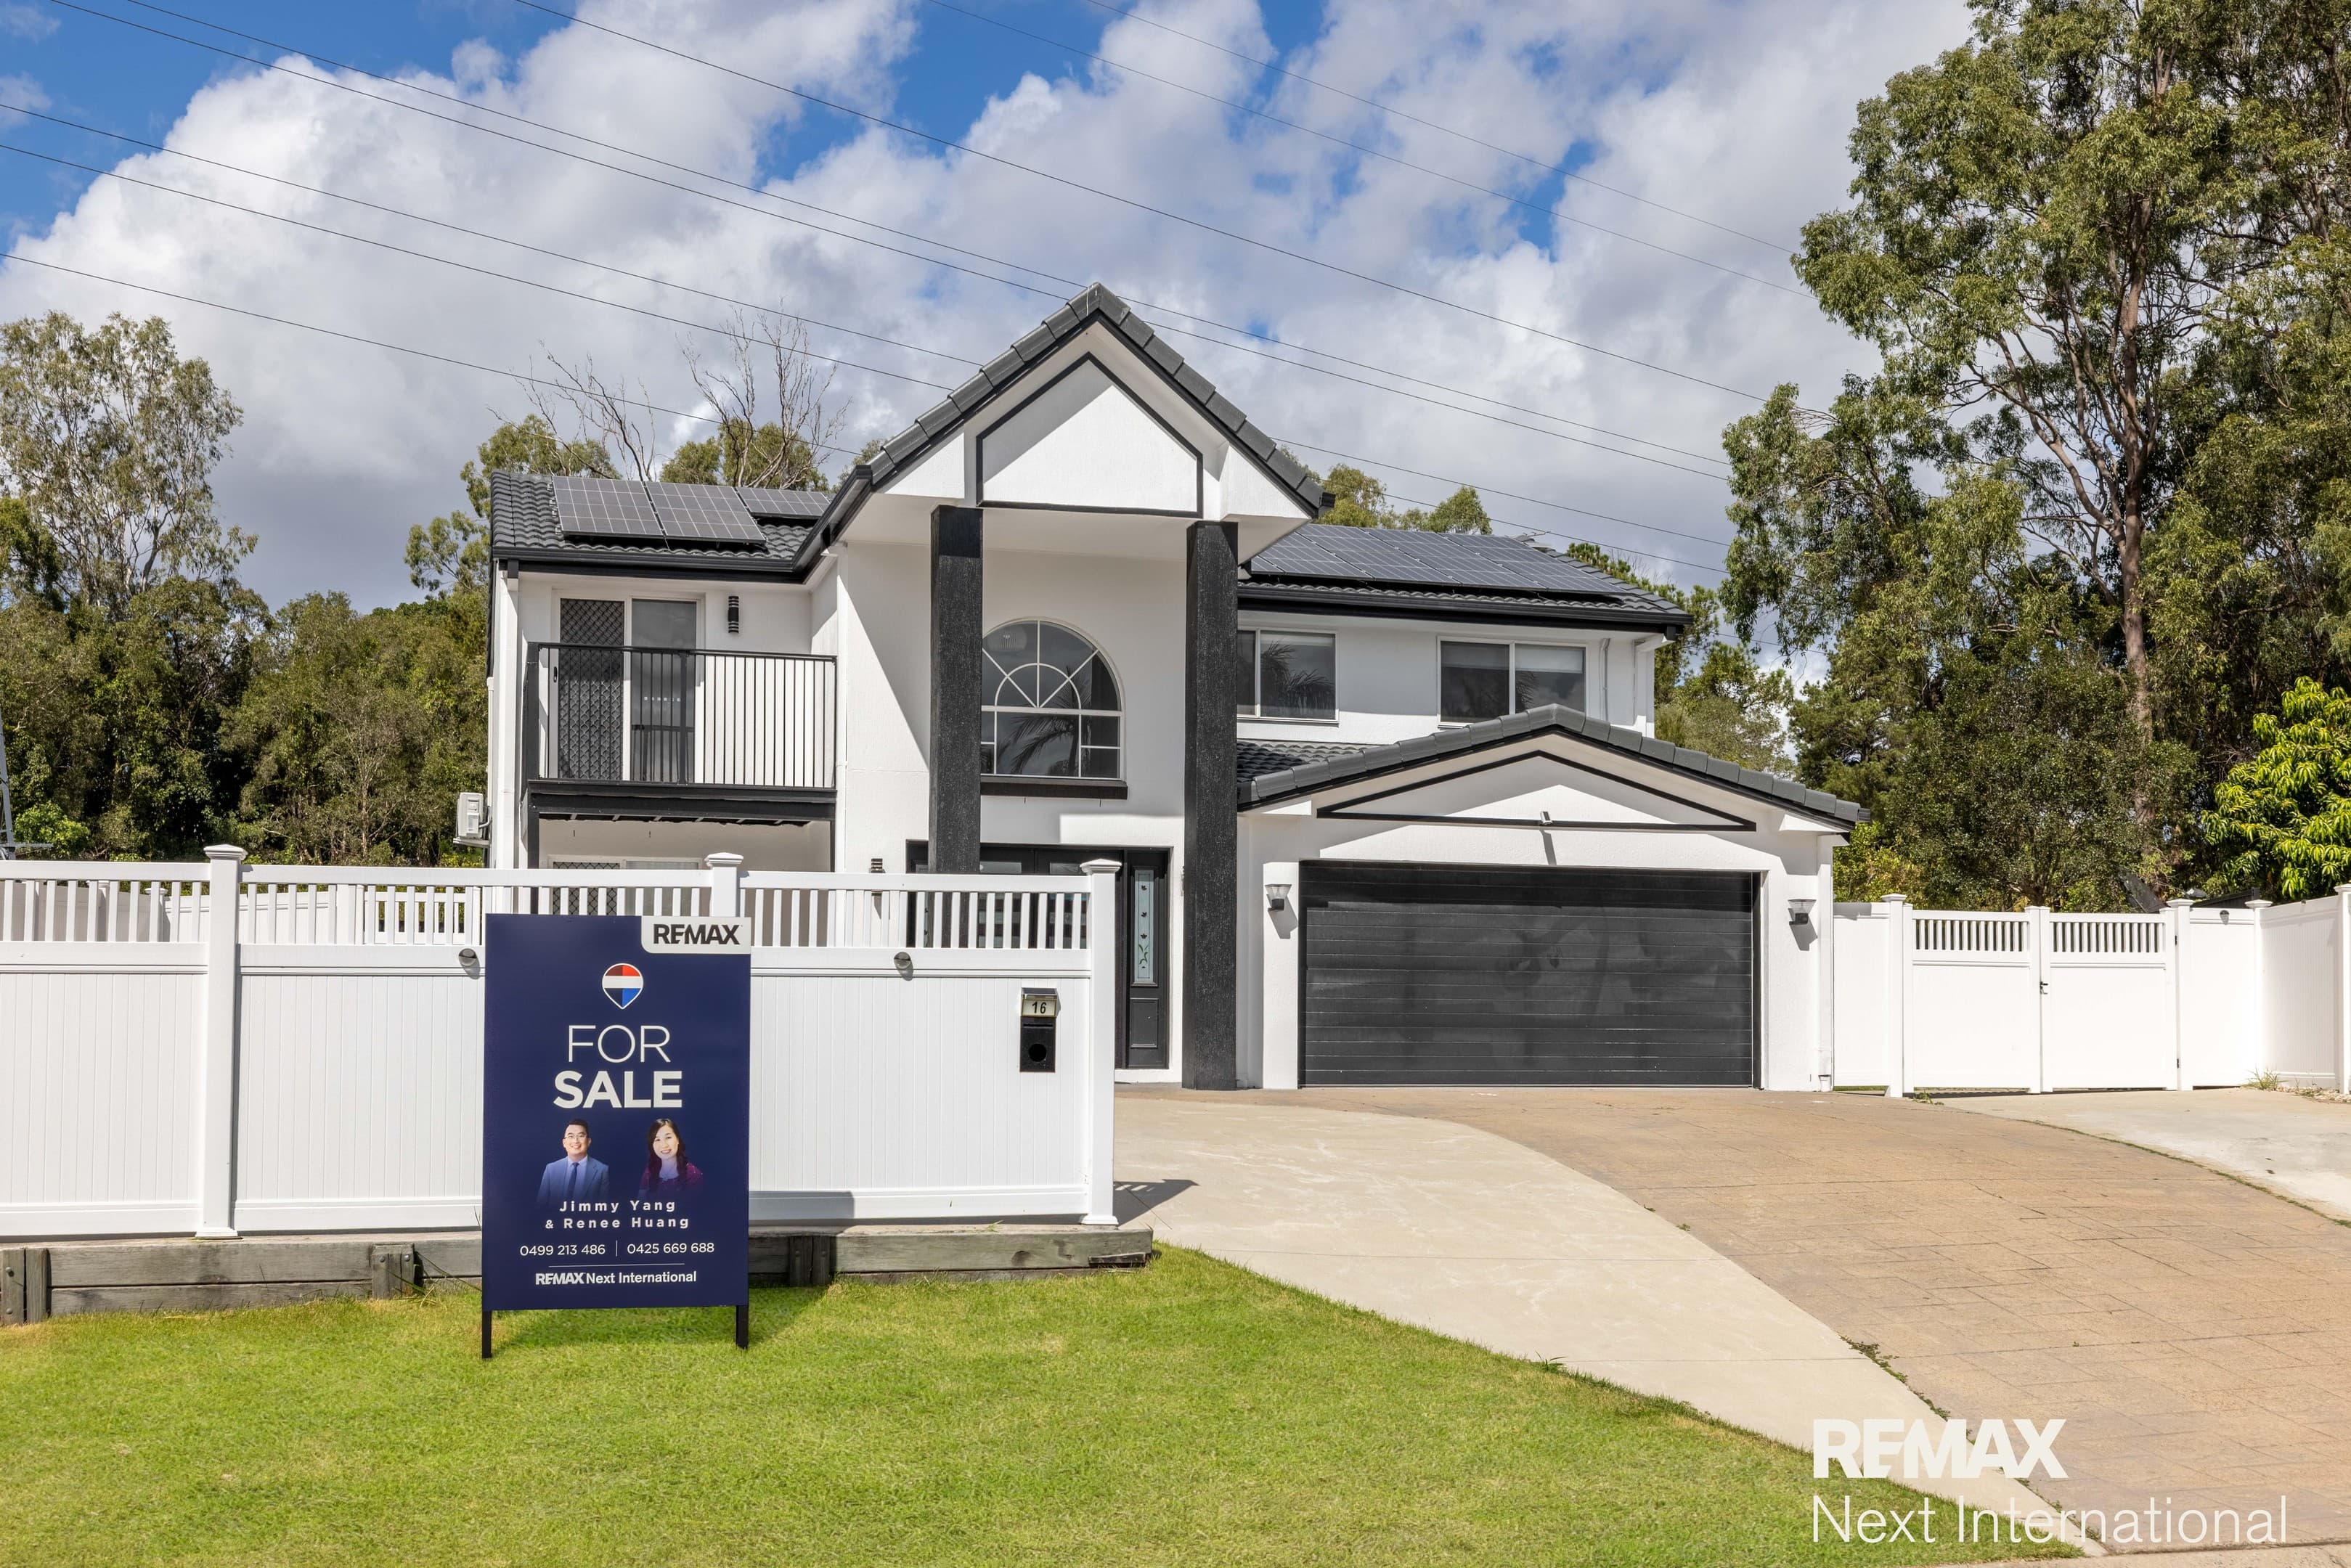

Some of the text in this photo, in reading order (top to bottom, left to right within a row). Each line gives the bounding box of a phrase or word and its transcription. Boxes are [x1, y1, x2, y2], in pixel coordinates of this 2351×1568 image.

[653, 923, 741, 945] REMAX
[1032, 1001, 1047, 1014] 16
[569, 1024, 671, 1063] FOR
[553, 1070, 683, 1108] SALE
[559, 1200, 675, 1213] Jimmy Yang
[545, 1217, 689, 1229] & Renee Huang
[519, 1244, 606, 1256] 0499 213 486
[627, 1242, 714, 1254] 0425 669 688
[535, 1270, 697, 1285] REMAX Next International
